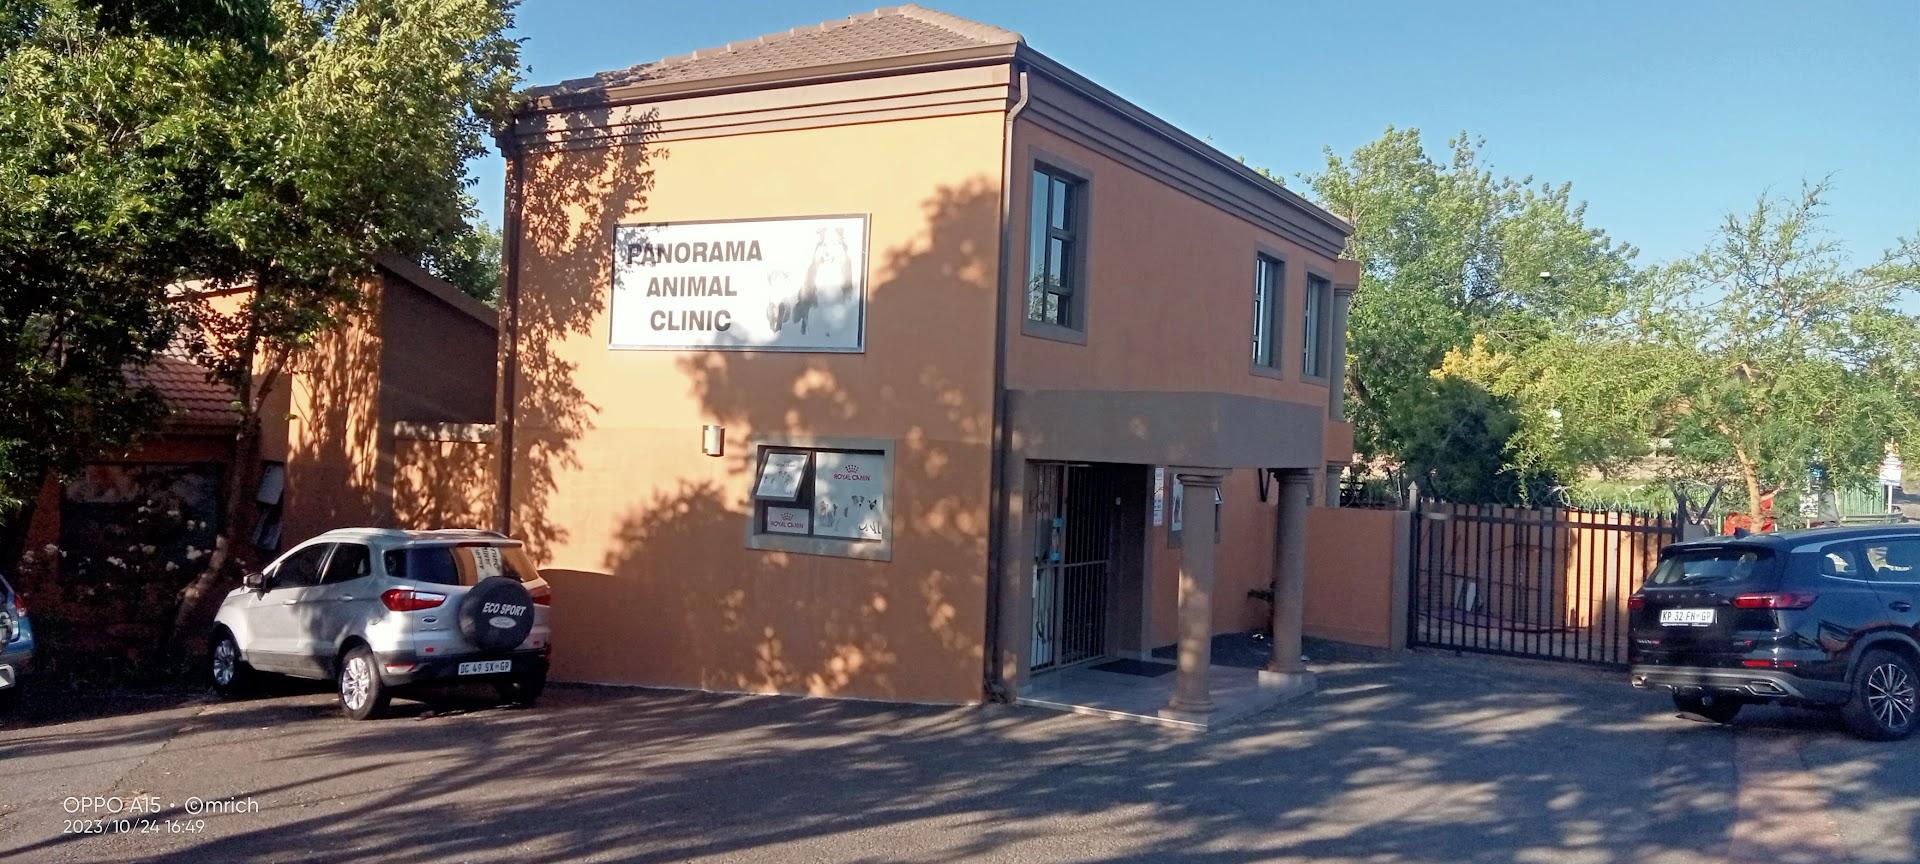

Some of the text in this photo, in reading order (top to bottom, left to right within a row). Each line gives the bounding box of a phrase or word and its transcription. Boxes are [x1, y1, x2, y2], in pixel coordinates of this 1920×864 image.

[627, 240, 763, 265] PANORAMA
[646, 275, 738, 298] ANIMAL
[650, 310, 732, 332] CLINIC
[833, 473, 851, 481] ROYAL
[482, 602, 527, 617] ECO SPORT
[1662, 611, 1712, 621] KP 32 FN GP
[473, 663, 482, 673] 49
[500, 661, 510, 671] GP
